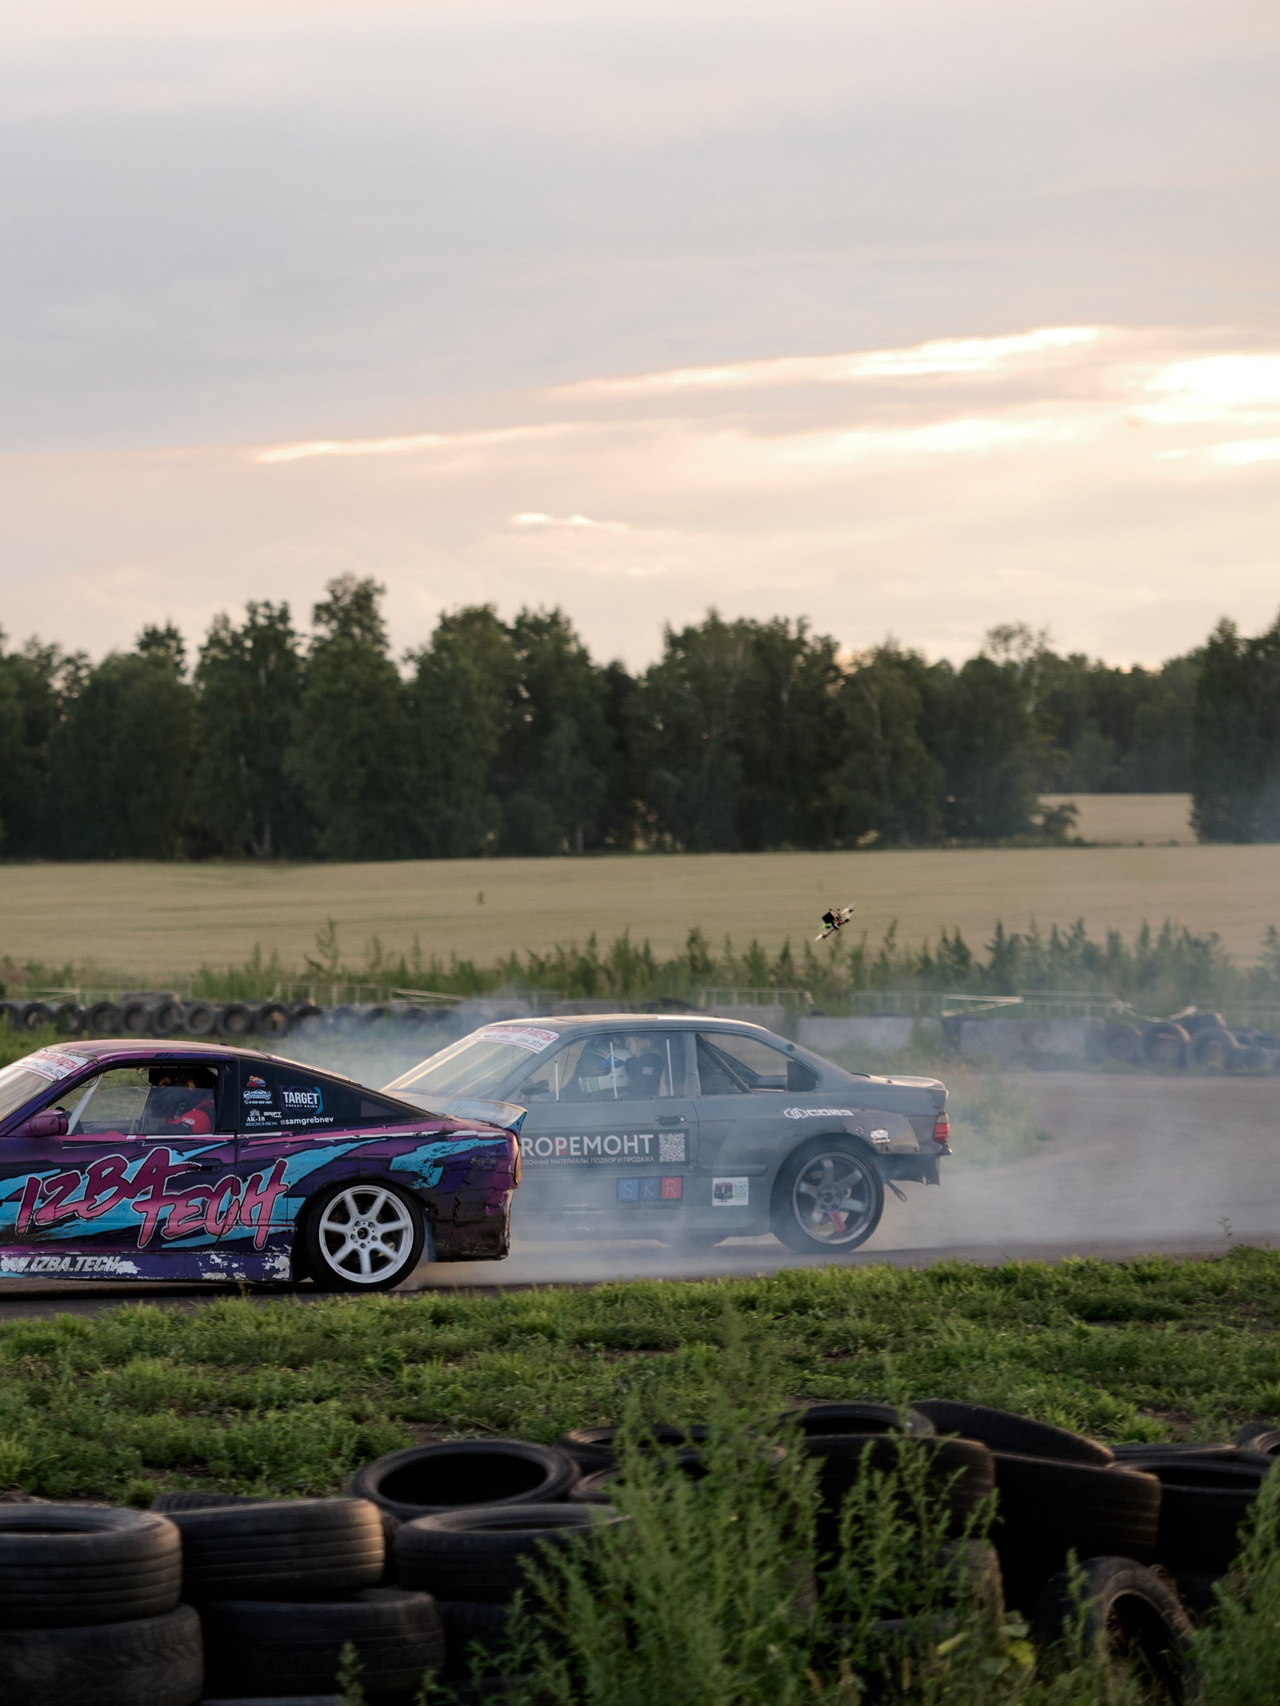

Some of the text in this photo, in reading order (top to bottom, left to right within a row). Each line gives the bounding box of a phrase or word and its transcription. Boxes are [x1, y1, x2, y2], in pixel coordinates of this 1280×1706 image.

[282, 1092, 319, 1105] TARGET
[280, 1116, 334, 1126] @samgrebnev
[624, 1156, 654, 1164] ПРОДАЖА
[14, 1146, 201, 1236] IZBA
[622, 1180, 677, 1199] SKR
[131, 1158, 290, 1251] TECH
